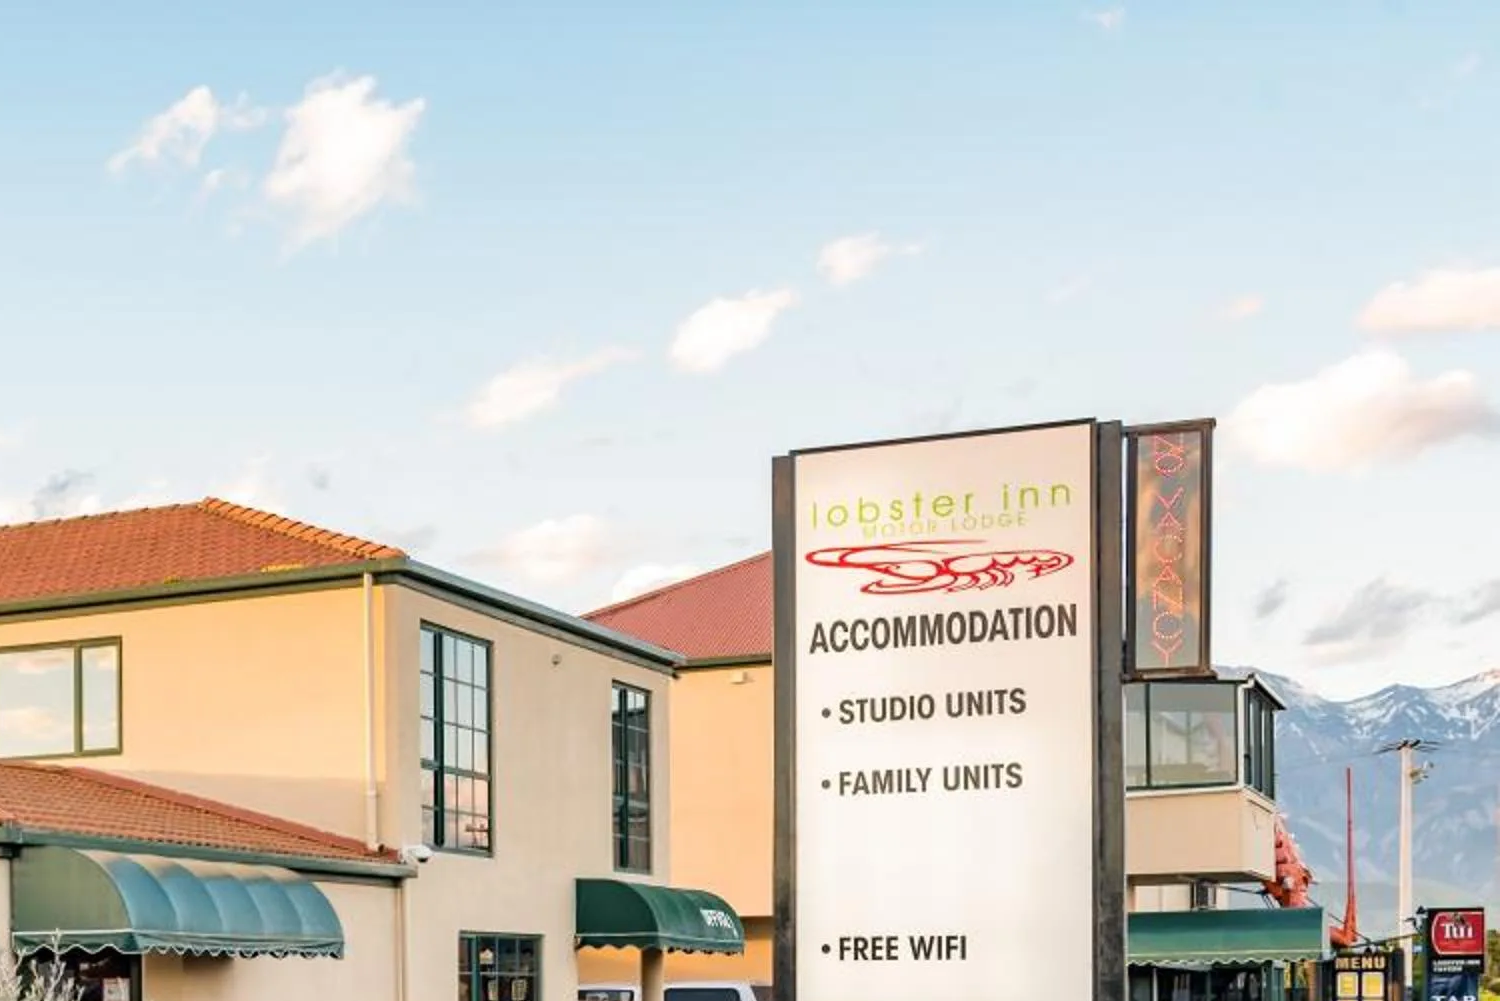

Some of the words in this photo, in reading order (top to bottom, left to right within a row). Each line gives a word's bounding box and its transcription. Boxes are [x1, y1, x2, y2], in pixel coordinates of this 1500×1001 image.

[812, 490, 975, 530] lobster
[1002, 483, 1072, 511] inn
[951, 511, 1028, 533] LODGE
[808, 603, 1078, 654] ACCOMMODATION
[838, 693, 936, 725] STUDIO
[945, 687, 1027, 718] UNITS
[838, 767, 932, 796] FAMILY
[942, 762, 1023, 791] UNITS
[838, 936, 899, 962] FREE
[908, 935, 968, 961] WIFI
[1335, 955, 1386, 970] MENU
